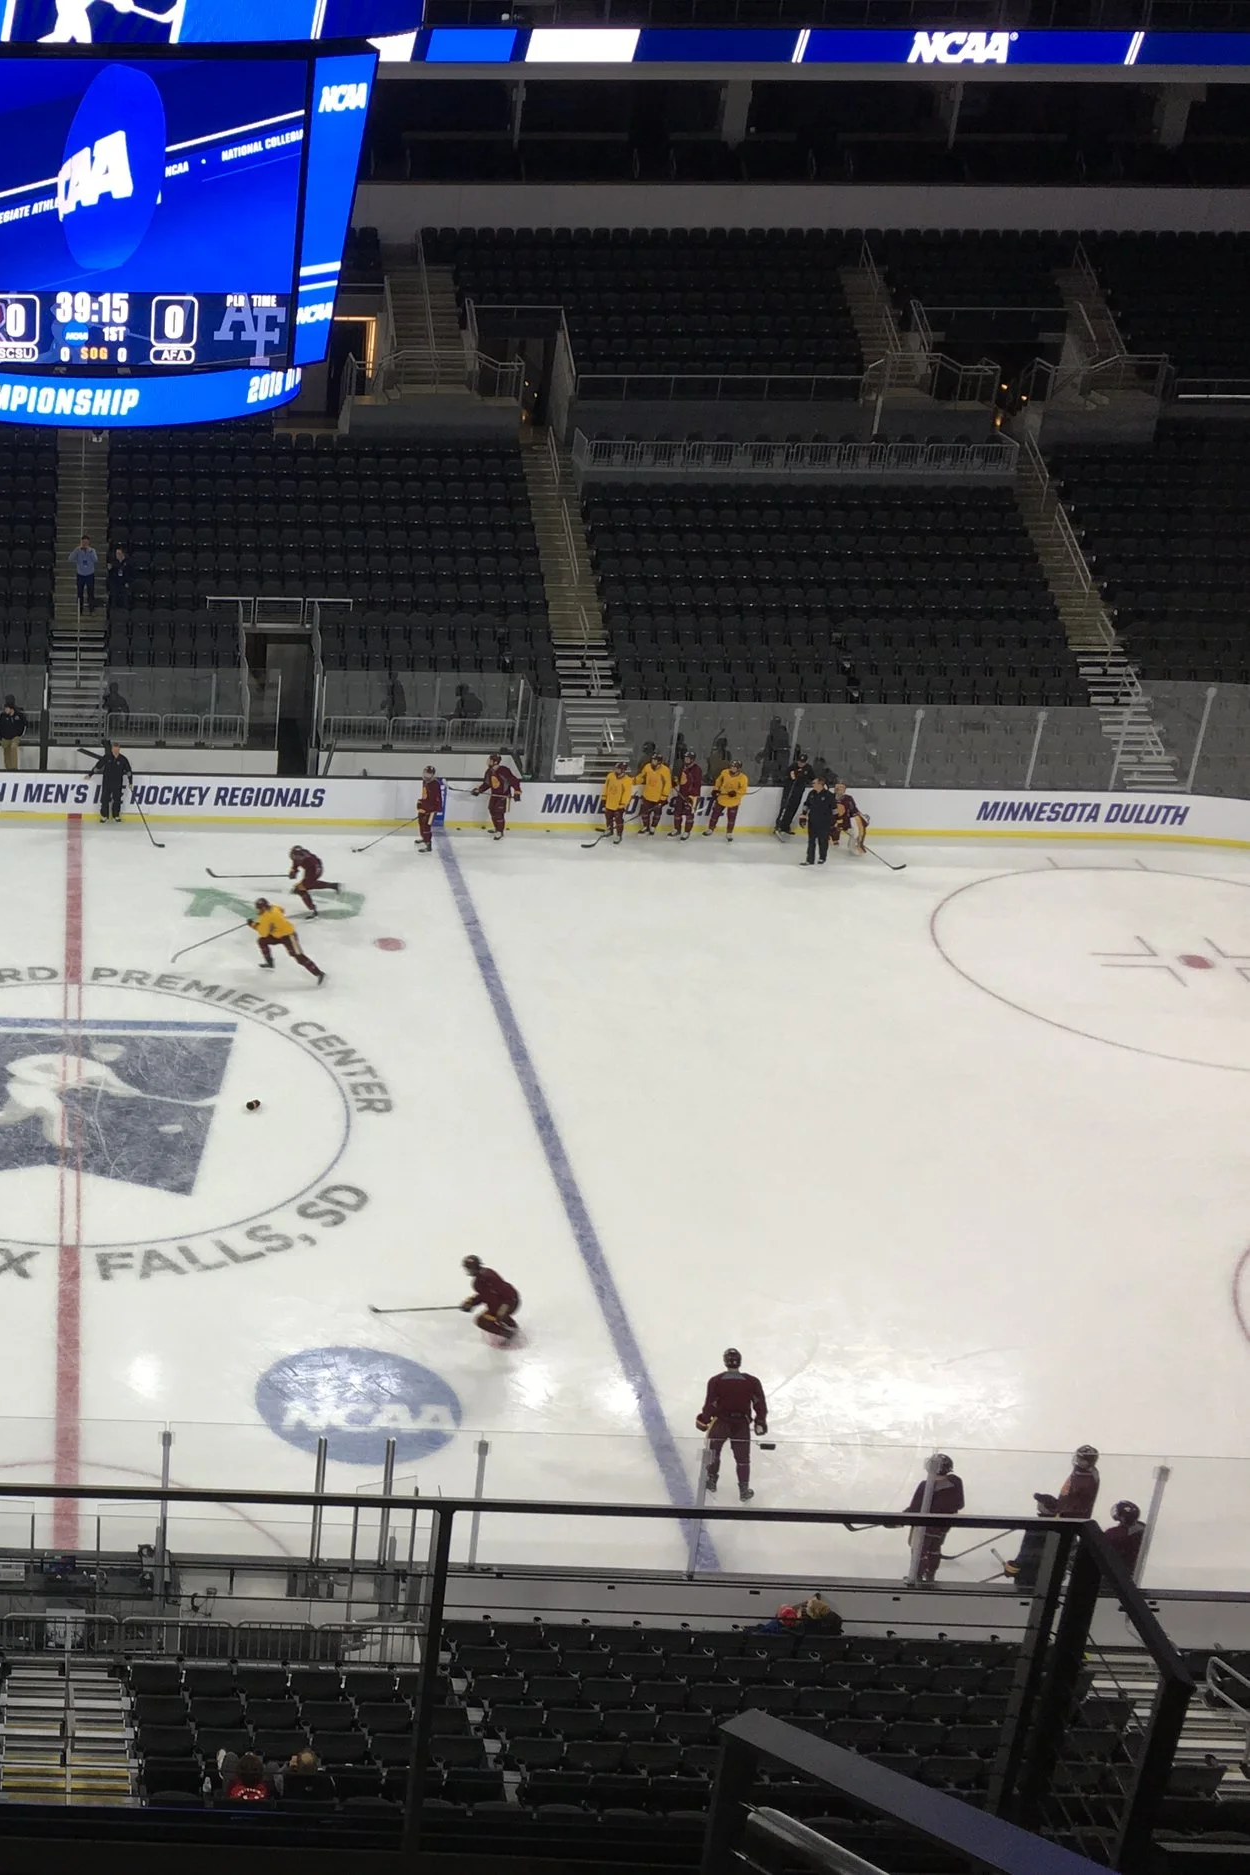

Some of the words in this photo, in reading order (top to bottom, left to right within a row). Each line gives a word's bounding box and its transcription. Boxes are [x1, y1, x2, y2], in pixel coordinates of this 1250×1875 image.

[907, 31, 1010, 63] NCAA
[318, 82, 368, 113] NCAA
[165, 161, 189, 178] NCAA
[221, 144, 264, 162] NATIONAL
[55, 291, 129, 324] 39:15
[251, 295, 277, 308] TIME
[296, 301, 334, 326] NCAA
[6, 303, 26, 338] 0
[102, 326, 127, 342] 1ST
[164, 304, 185, 339] 0
[80, 346, 108, 361] SOG
[160, 349, 187, 361] AFA
[247, 371, 284, 404] 2018
[10, 783, 19, 803] I
[23, 783, 89, 804] MEN'S
[130, 785, 211, 807] HOCKEY
[213, 786, 326, 808] REGIONALS
[976, 801, 1101, 823] MINNESOTA
[1103, 803, 1190, 826] DULUTH
[90, 966, 291, 1021] PREMIER
[290, 1021, 394, 1114] CENTER
[280, 1400, 461, 1435] NCAA
